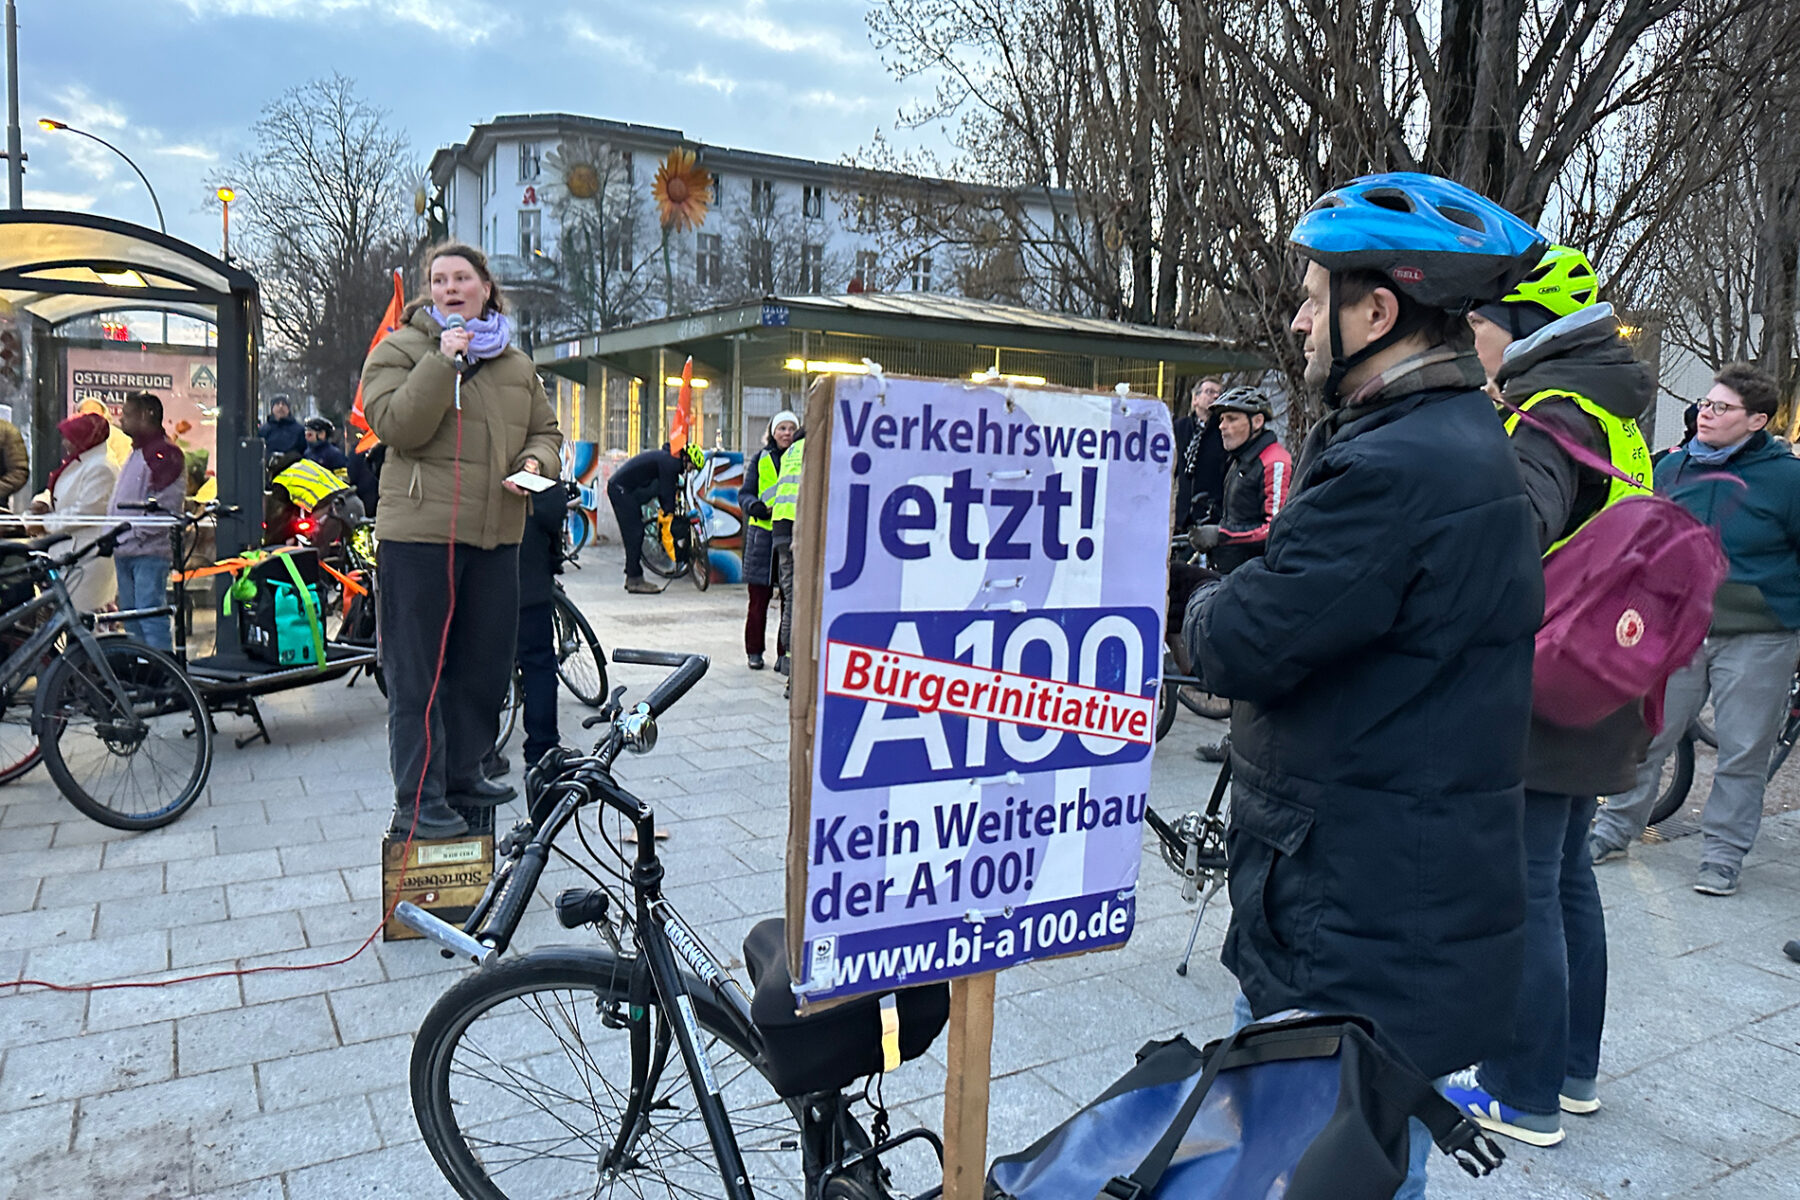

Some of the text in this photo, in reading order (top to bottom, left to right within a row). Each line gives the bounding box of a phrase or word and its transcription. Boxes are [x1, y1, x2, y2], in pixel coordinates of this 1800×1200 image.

[74, 372, 172, 388] OSTERFREUDE
[841, 400, 1171, 463] Verkehrswende
[830, 452, 1098, 591] jetzt!
[839, 615, 1144, 779] A100
[842, 649, 1148, 737] Bürgerinitiative
[813, 787, 1146, 865] Kein Weiterbau
[812, 848, 1035, 923] der A100!
[833, 900, 1127, 987] www.bi-a100.de
